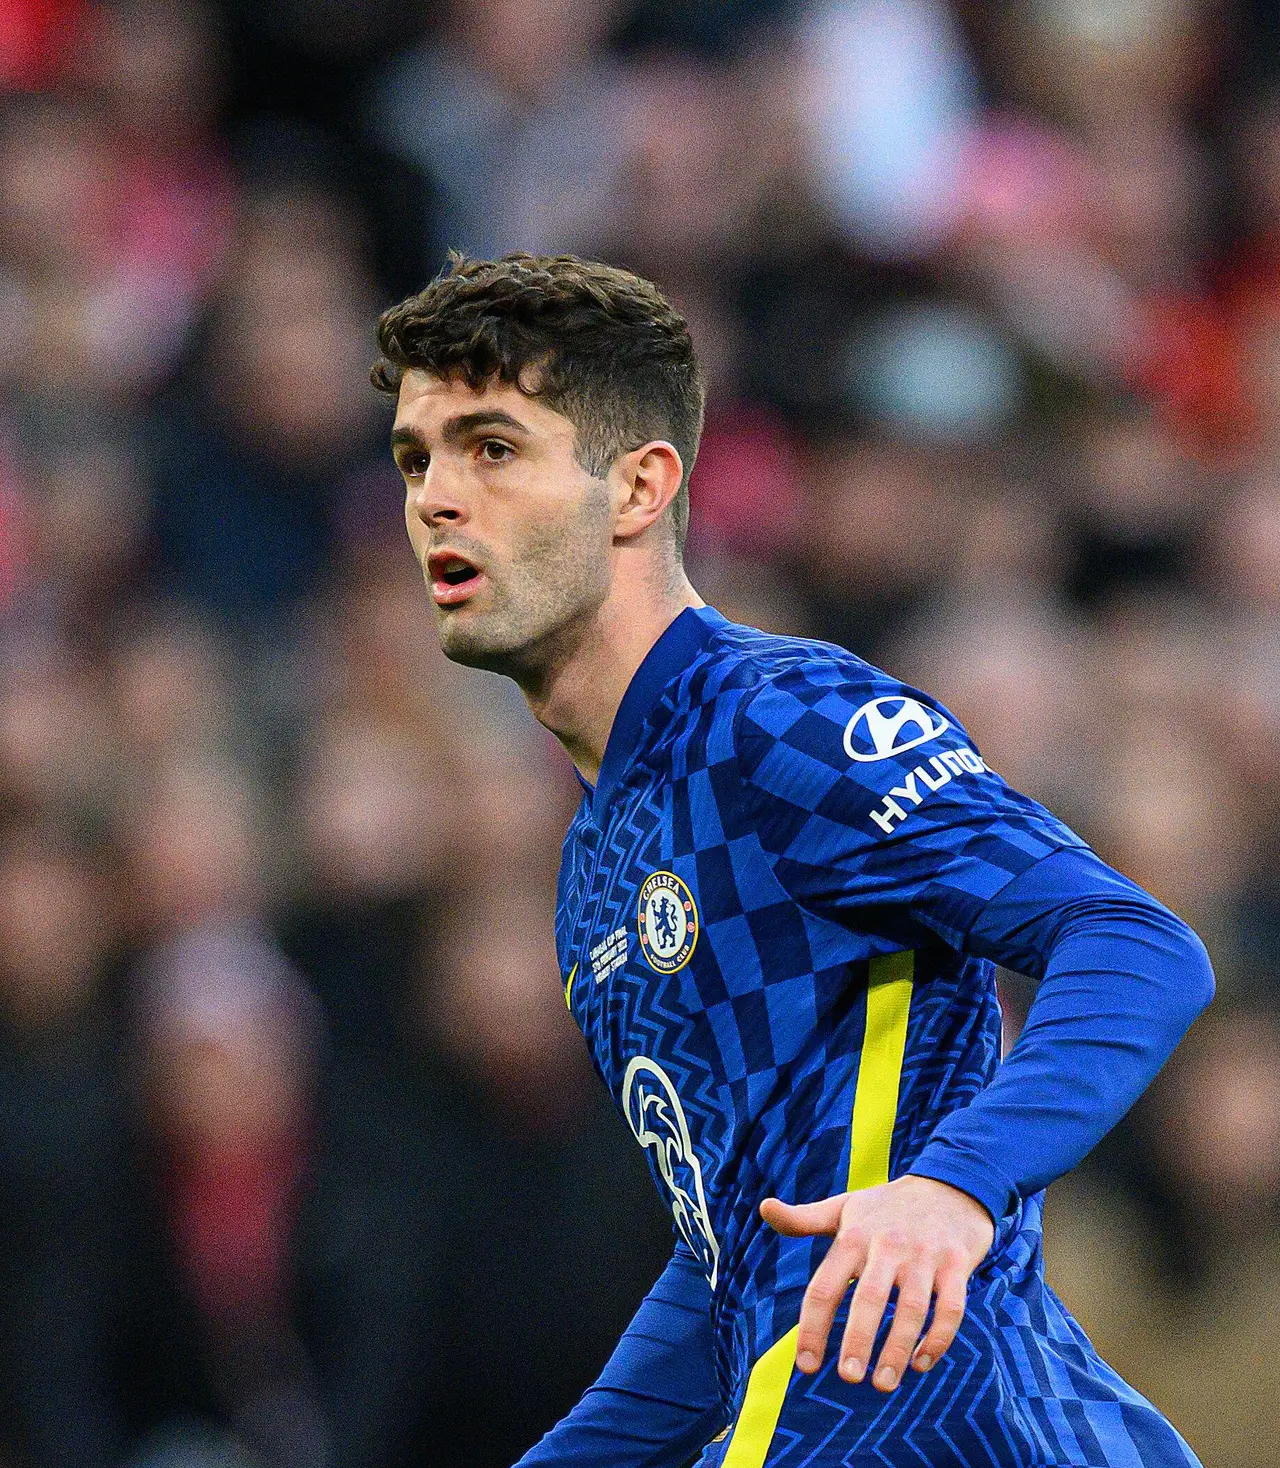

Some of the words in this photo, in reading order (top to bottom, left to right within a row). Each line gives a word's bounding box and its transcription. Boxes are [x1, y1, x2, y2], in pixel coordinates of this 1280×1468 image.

[869, 748, 993, 834] HYUND
[643, 876, 680, 901] CHELSEA
[677, 944, 690, 963] CLUB
